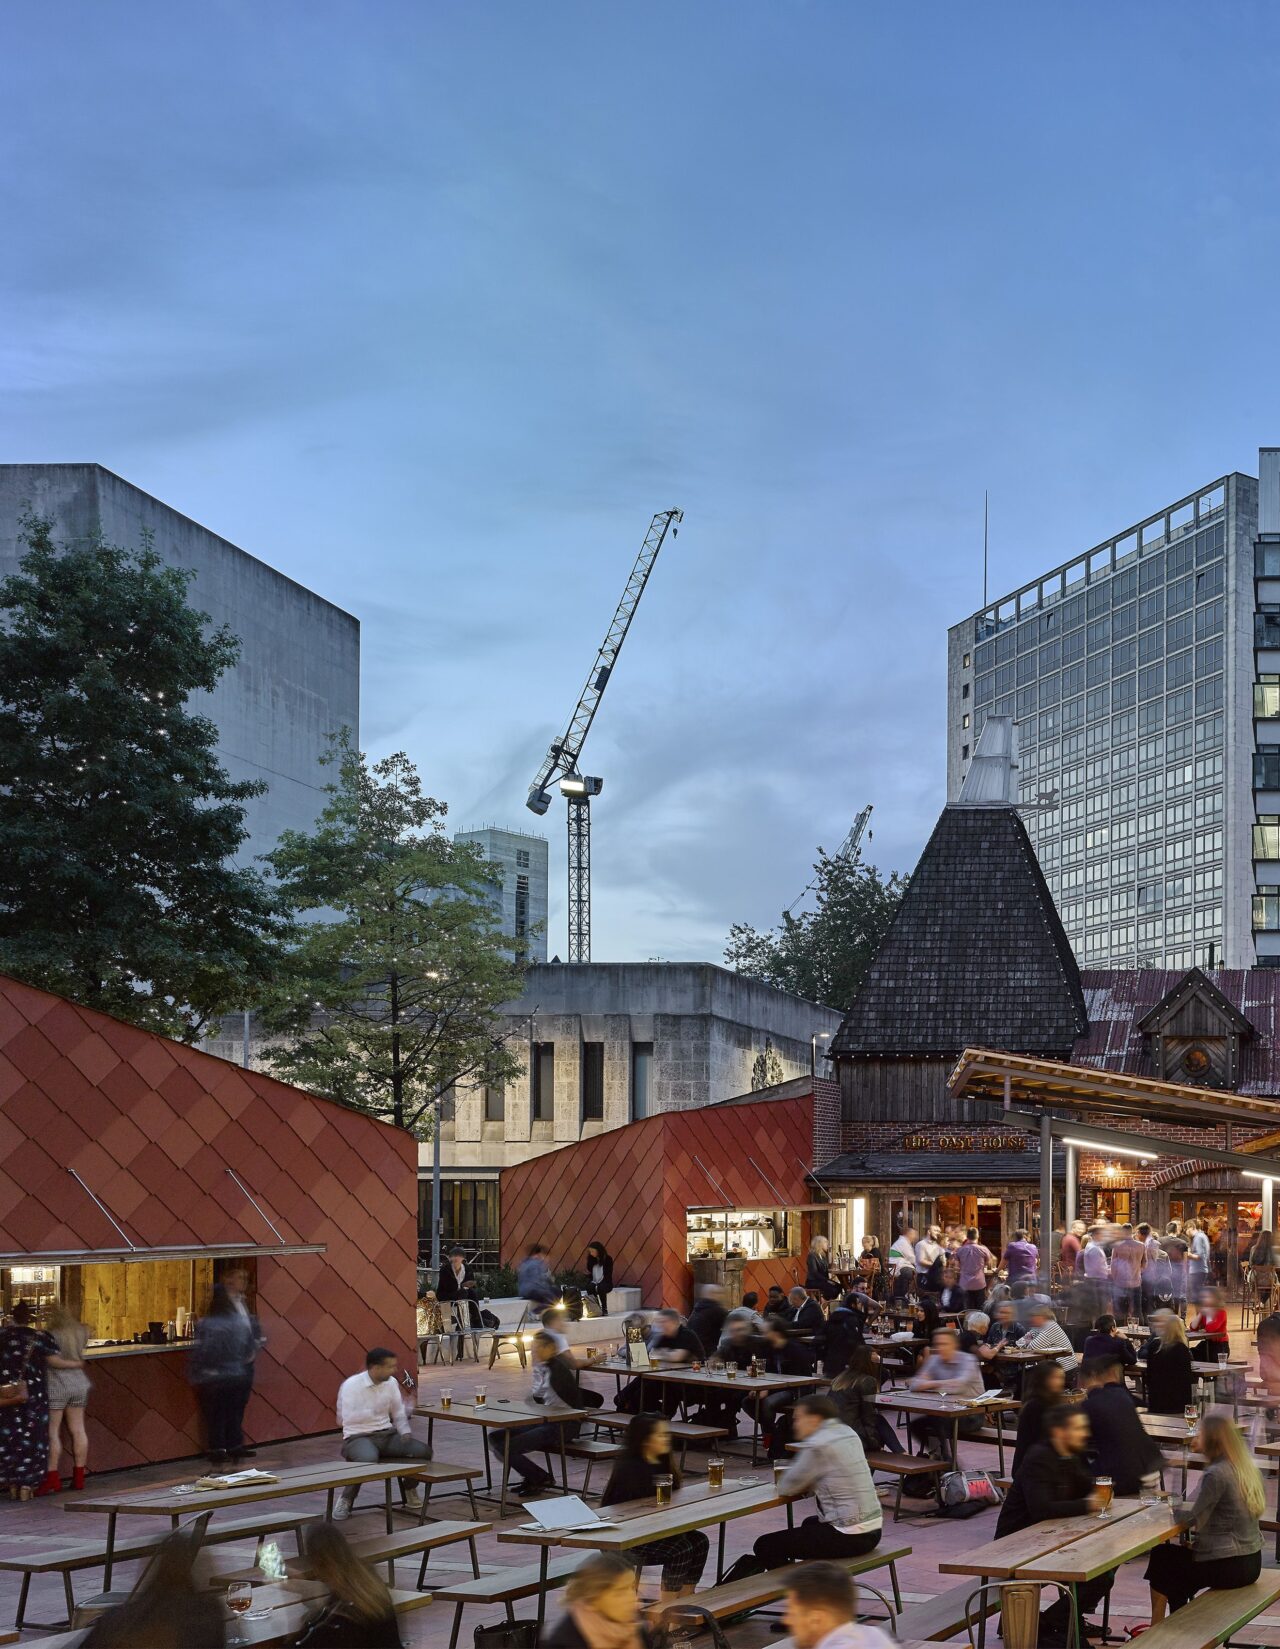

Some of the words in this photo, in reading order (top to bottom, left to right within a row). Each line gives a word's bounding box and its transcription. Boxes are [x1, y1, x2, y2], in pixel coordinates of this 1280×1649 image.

[904, 1135, 931, 1149] THE
[939, 1135, 975, 1149] OAST
[981, 1135, 1025, 1149] HOUSE
